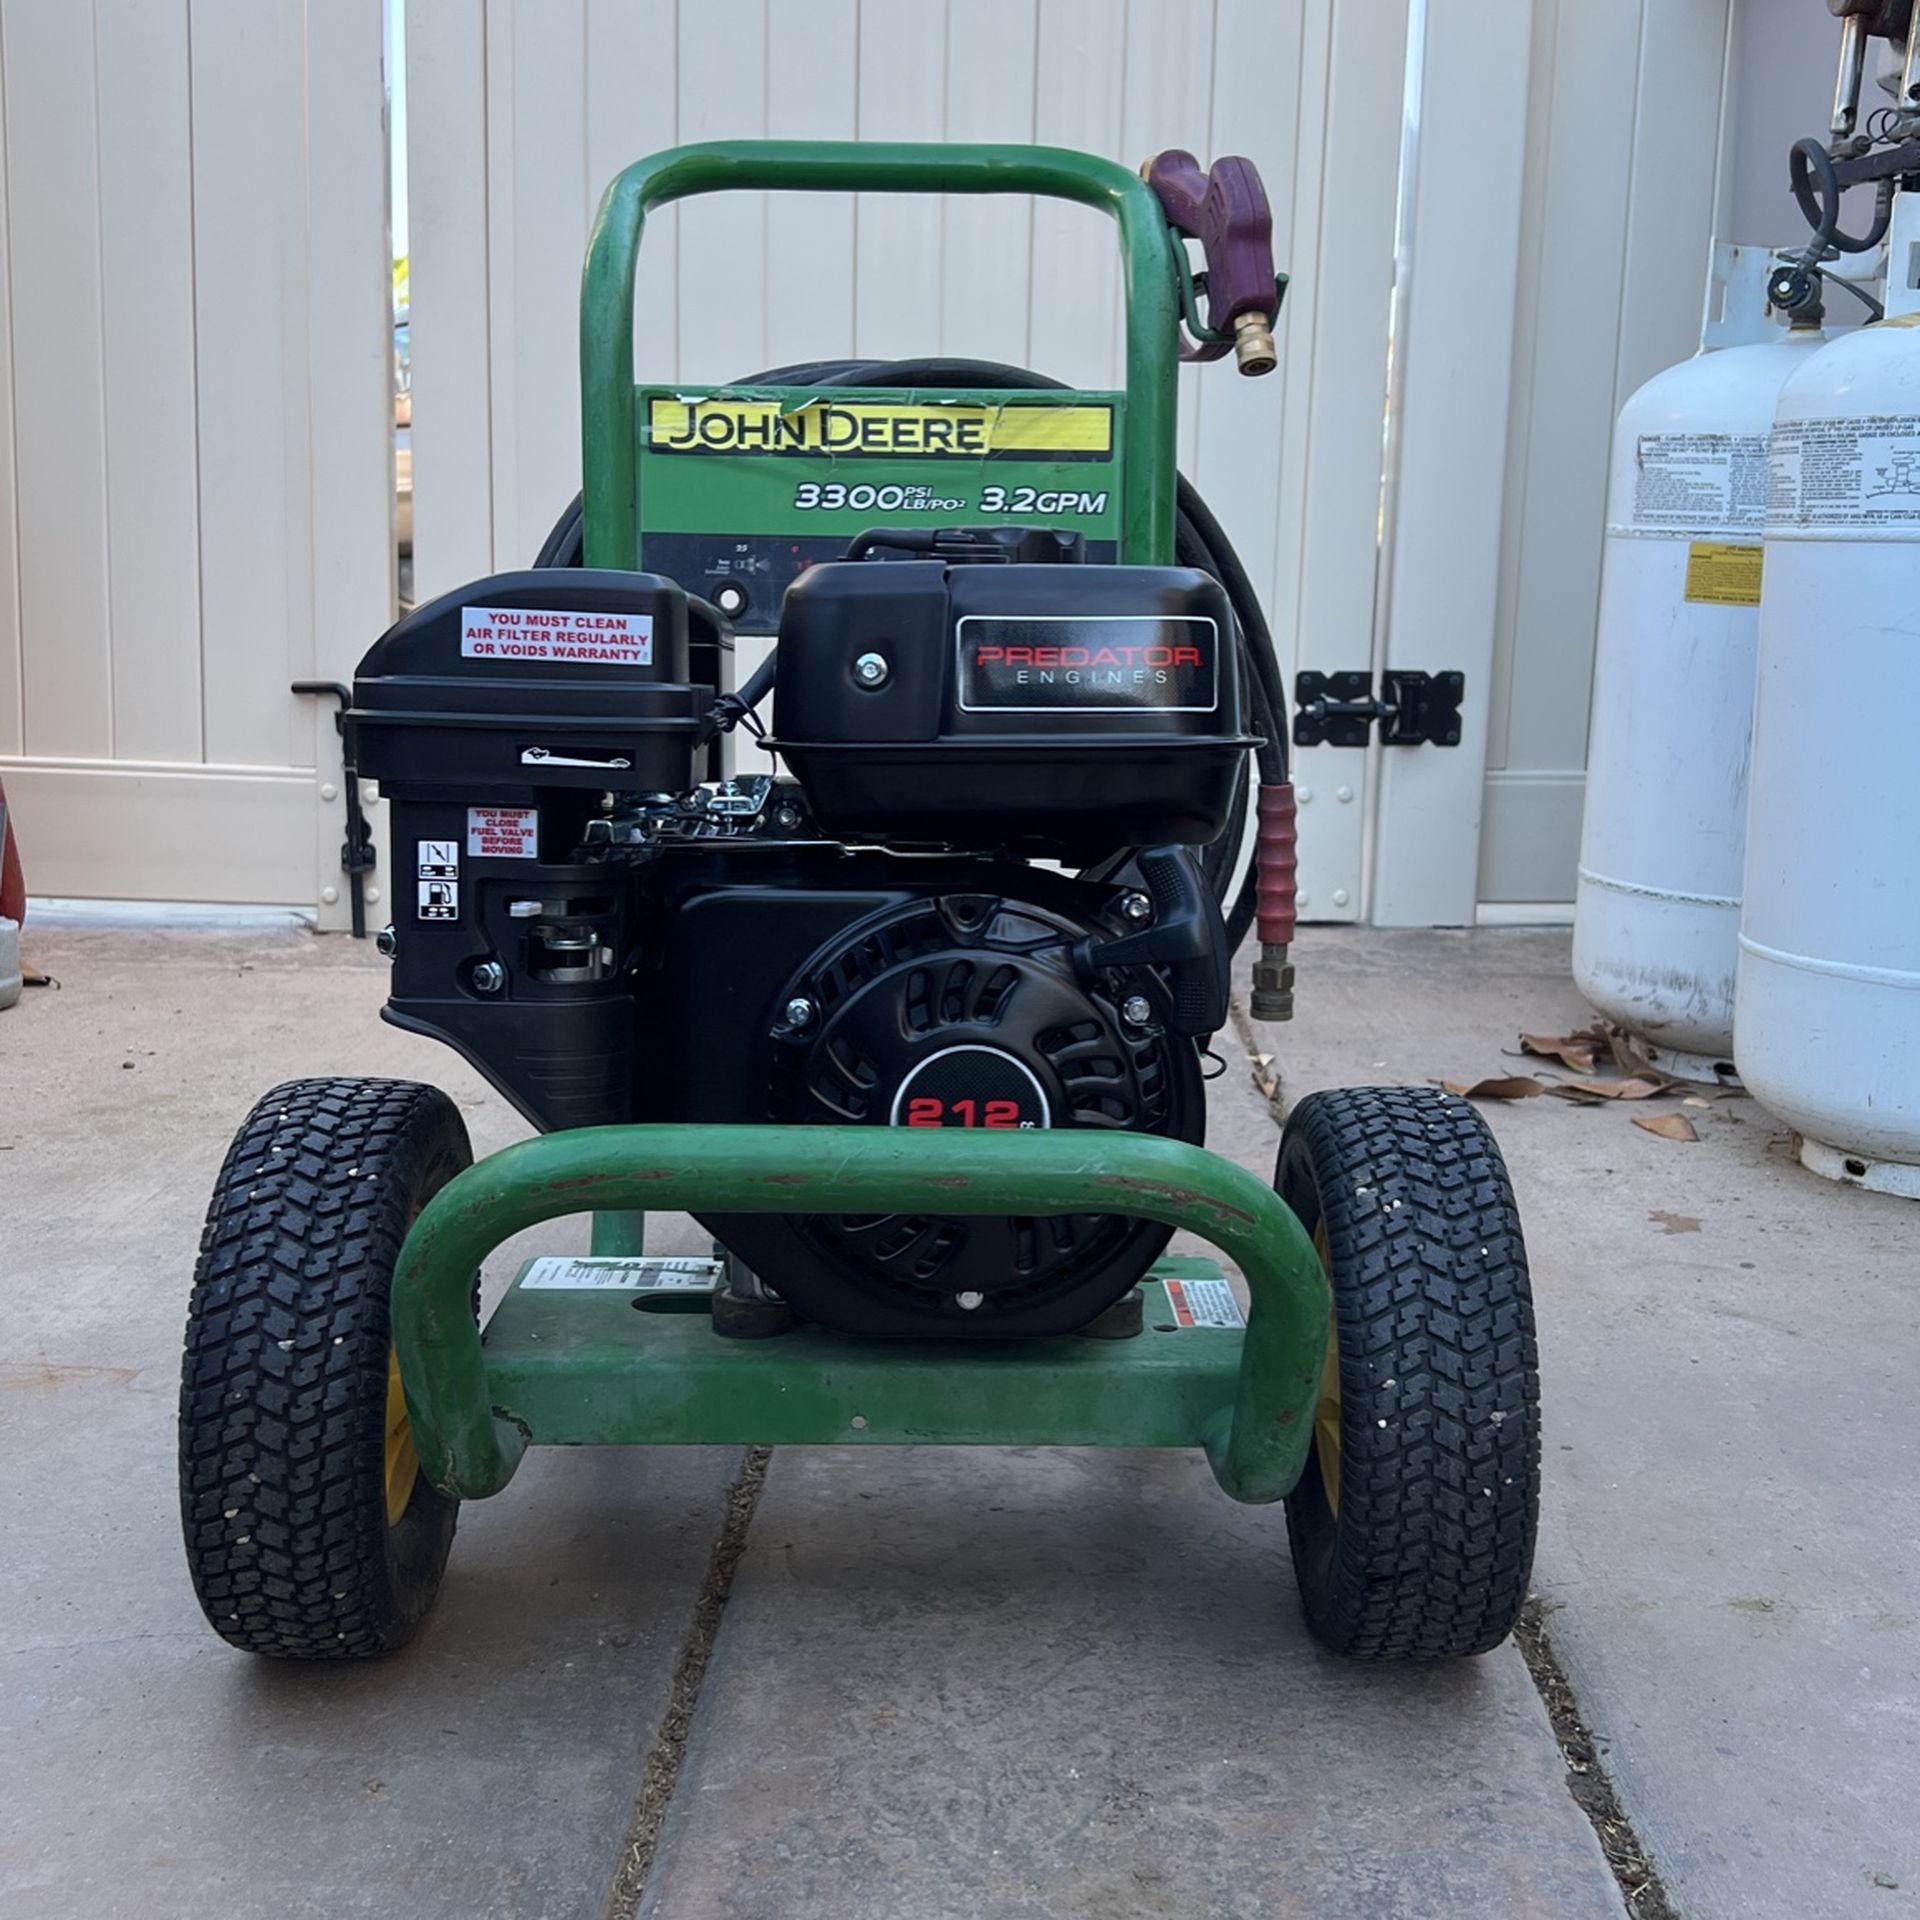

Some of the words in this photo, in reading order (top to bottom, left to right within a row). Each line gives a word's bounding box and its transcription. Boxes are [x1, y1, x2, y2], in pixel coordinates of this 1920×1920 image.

[669, 404, 806, 446] JOHN
[820, 408, 985, 450] DEERE
[794, 483, 904, 510] 3300
[903, 486, 933, 498] PSI
[980, 486, 1107, 513] 3.2GPM
[488, 613, 521, 626] YOU
[526, 614, 571, 627] MUST
[575, 617, 628, 630] CLEAN
[466, 628, 493, 640] AIR
[498, 628, 552, 642] FILTER
[556, 631, 648, 647] REGULARLY
[473, 643, 495, 655] OR
[500, 644, 548, 657] VOIDS
[552, 646, 641, 661] WARRANTY
[976, 646, 1202, 668] PREDATOR
[1016, 670, 1168, 684] ENGINES
[475, 810, 498, 818] YOU
[500, 810, 530, 819] MUST
[485, 818, 519, 827] CLOSE
[471, 827, 498, 836] FUEL
[500, 828, 534, 838] VALVE
[481, 836, 523, 846] BEFORE
[481, 845, 524, 855] MOVING
[908, 1098, 1019, 1129] 212
